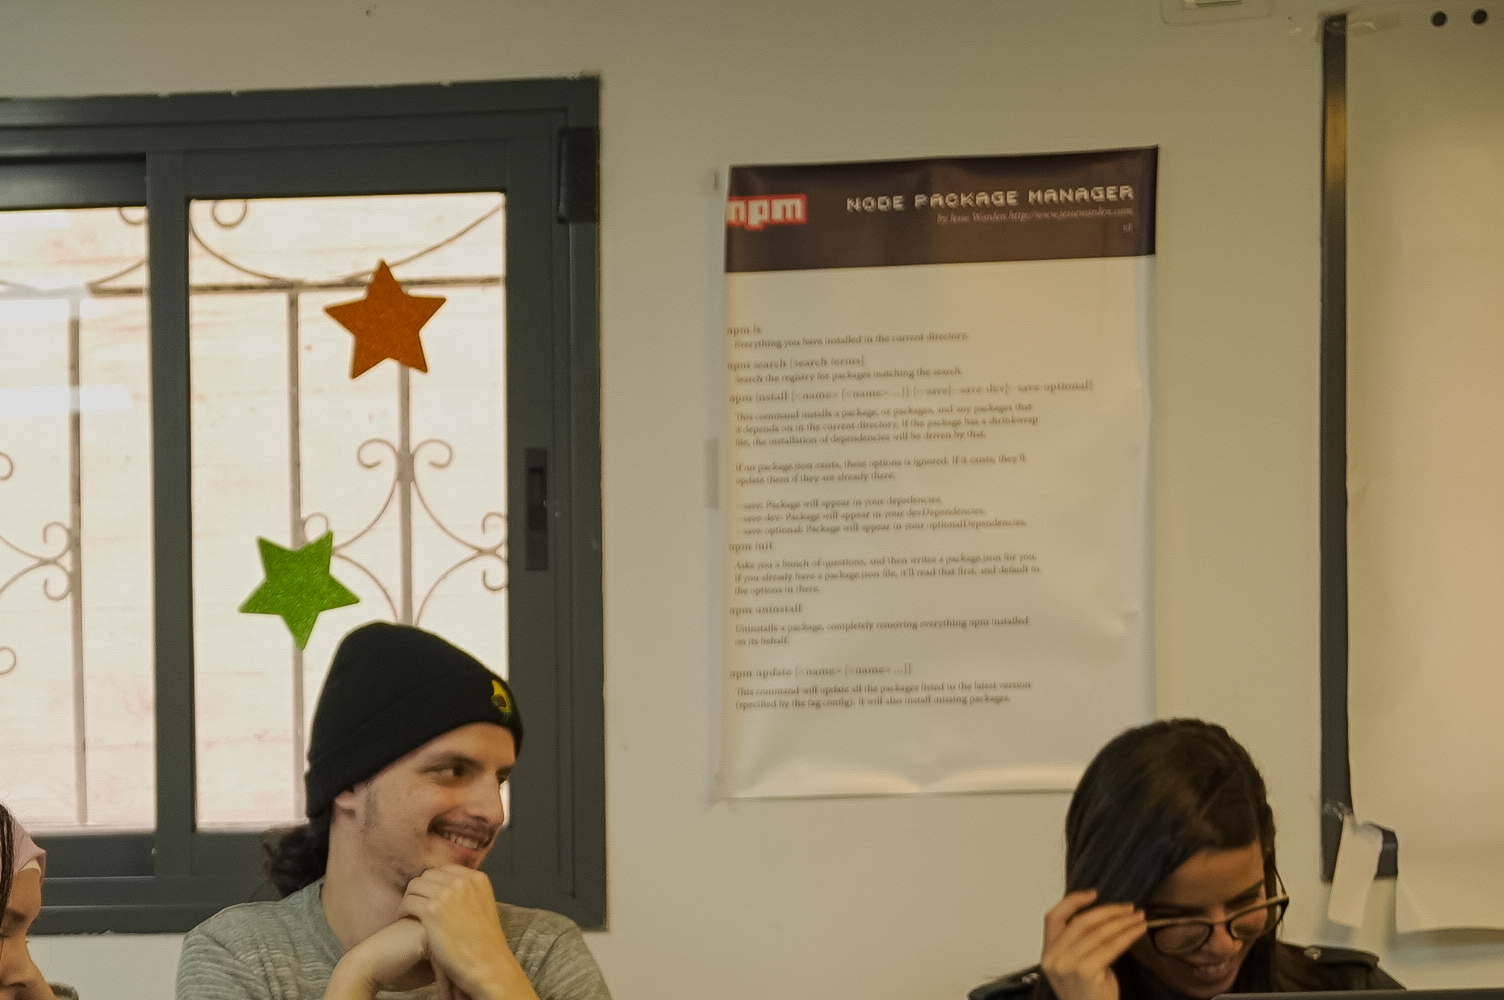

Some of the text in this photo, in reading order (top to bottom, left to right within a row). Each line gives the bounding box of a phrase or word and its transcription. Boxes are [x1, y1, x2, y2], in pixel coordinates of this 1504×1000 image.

[846, 185, 1135, 213] NODE PACKAGE MANAGER
[726, 197, 803, 228] npm
[727, 325, 762, 337] npm ls
[784, 339, 801, 348] you
[802, 337, 824, 347] have
[825, 334, 863, 345] installed
[875, 334, 890, 344] the
[891, 333, 925, 343] current
[727, 362, 751, 372] npm
[753, 359, 787, 370] search
[765, 373, 780, 383] the
[781, 373, 815, 384] registry
[816, 371, 830, 381] for
[831, 371, 872, 382] packages
[873, 369, 916, 380] matching
[916, 367, 931, 377] the
[729, 395, 753, 405] npm
[755, 391, 788, 402] install
[736, 412, 754, 422] This
[755, 412, 800, 421] command
[801, 409, 833, 419] installs
[938, 404, 954, 414] and
[973, 404, 1014, 415] packages
[1015, 402, 1034, 412] that
[744, 425, 781, 435] depends
[806, 422, 822, 432] the
[823, 422, 856, 431] current
[910, 420, 927, 429] the
[926, 419, 964, 429] package
[989, 416, 1040, 427] shrinkwrap
[752, 437, 768, 447] the
[768, 436, 818, 446] installation
[829, 434, 892, 445] dependencies
[893, 431, 910, 442] will
[923, 431, 953, 441] driven
[843, 459, 867, 469] these
[868, 459, 902, 469] options
[735, 476, 765, 487] update
[766, 475, 790, 485] them
[800, 474, 819, 484] they
[838, 472, 868, 483] already
[766, 500, 801, 511] Package
[804, 498, 820, 508] will
[822, 499, 850, 510] appear
[863, 498, 884, 507] your
[785, 512, 821, 523] Package
[822, 509, 839, 520] will
[840, 511, 870, 522] appear
[884, 510, 904, 519] your
[805, 525, 841, 536] Package
[843, 522, 859, 533] will
[861, 523, 891, 534] appear
[904, 522, 925, 531] your
[729, 541, 773, 554] npm init
[756, 562, 773, 570] you
[781, 559, 809, 569] bunch
[868, 556, 885, 566] and
[886, 556, 908, 565] then
[910, 555, 937, 564] writes
[1003, 552, 1017, 562] for
[743, 575, 760, 583] you
[761, 572, 793, 582] already
[794, 573, 815, 582] have
[916, 568, 937, 578] read
[937, 567, 956, 577] that
[980, 565, 997, 576] and
[998, 565, 1029, 575] default
[735, 586, 749, 595] the
[750, 586, 784, 596] options
[729, 603, 804, 617] npm uninstall
[735, 624, 779, 633] Uninstalls
[826, 621, 874, 632] completely
[875, 621, 918, 631] removing
[919, 619, 968, 630] everything
[968, 618, 990, 629] npm
[991, 615, 1030, 626] installed
[730, 670, 753, 681] npm
[754, 668, 793, 679] update
[736, 681, 1032, 697] This command will update the packages listed the latest version
[790, 699, 806, 709] the
[866, 696, 883, 707] will
[884, 696, 903, 707] also
[904, 695, 932, 705] install
[932, 696, 967, 707] missing
